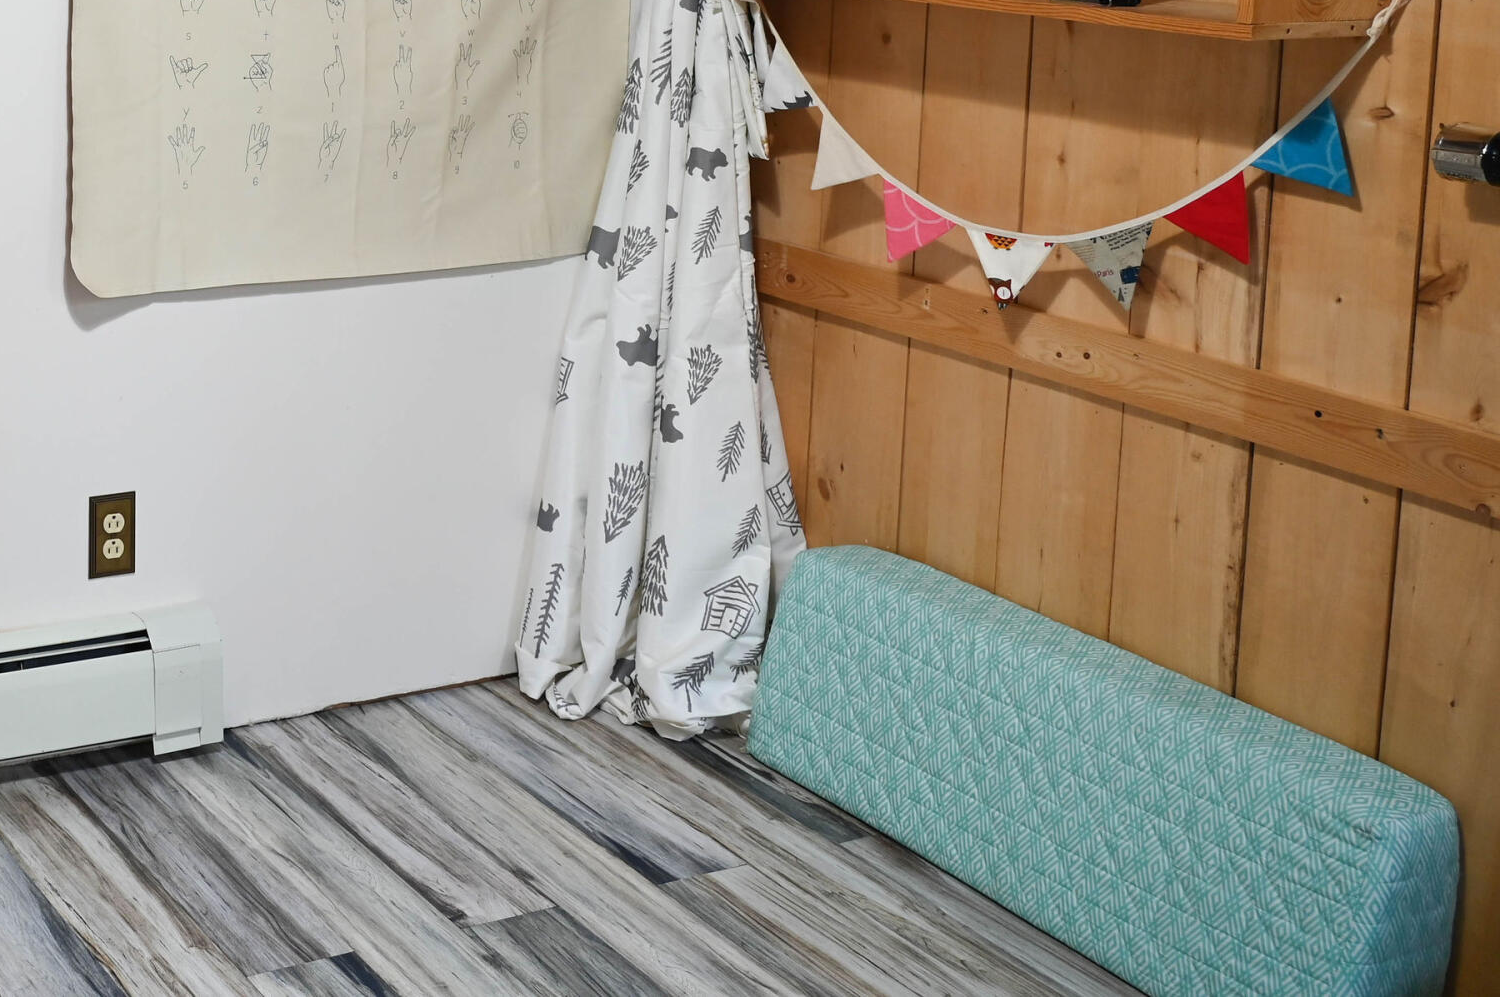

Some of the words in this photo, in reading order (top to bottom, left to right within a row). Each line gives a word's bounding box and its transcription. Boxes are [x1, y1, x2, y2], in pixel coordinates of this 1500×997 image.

[186, 32, 191, 41] s
[333, 33, 338, 41] u
[467, 29, 475, 37] w
[183, 109, 189, 119] y
[256, 106, 262, 114] z
[399, 100, 405, 110] 2
[462, 97, 467, 105] 3
[183, 181, 188, 190] 5
[252, 178, 258, 186] 6
[393, 172, 398, 180] 8
